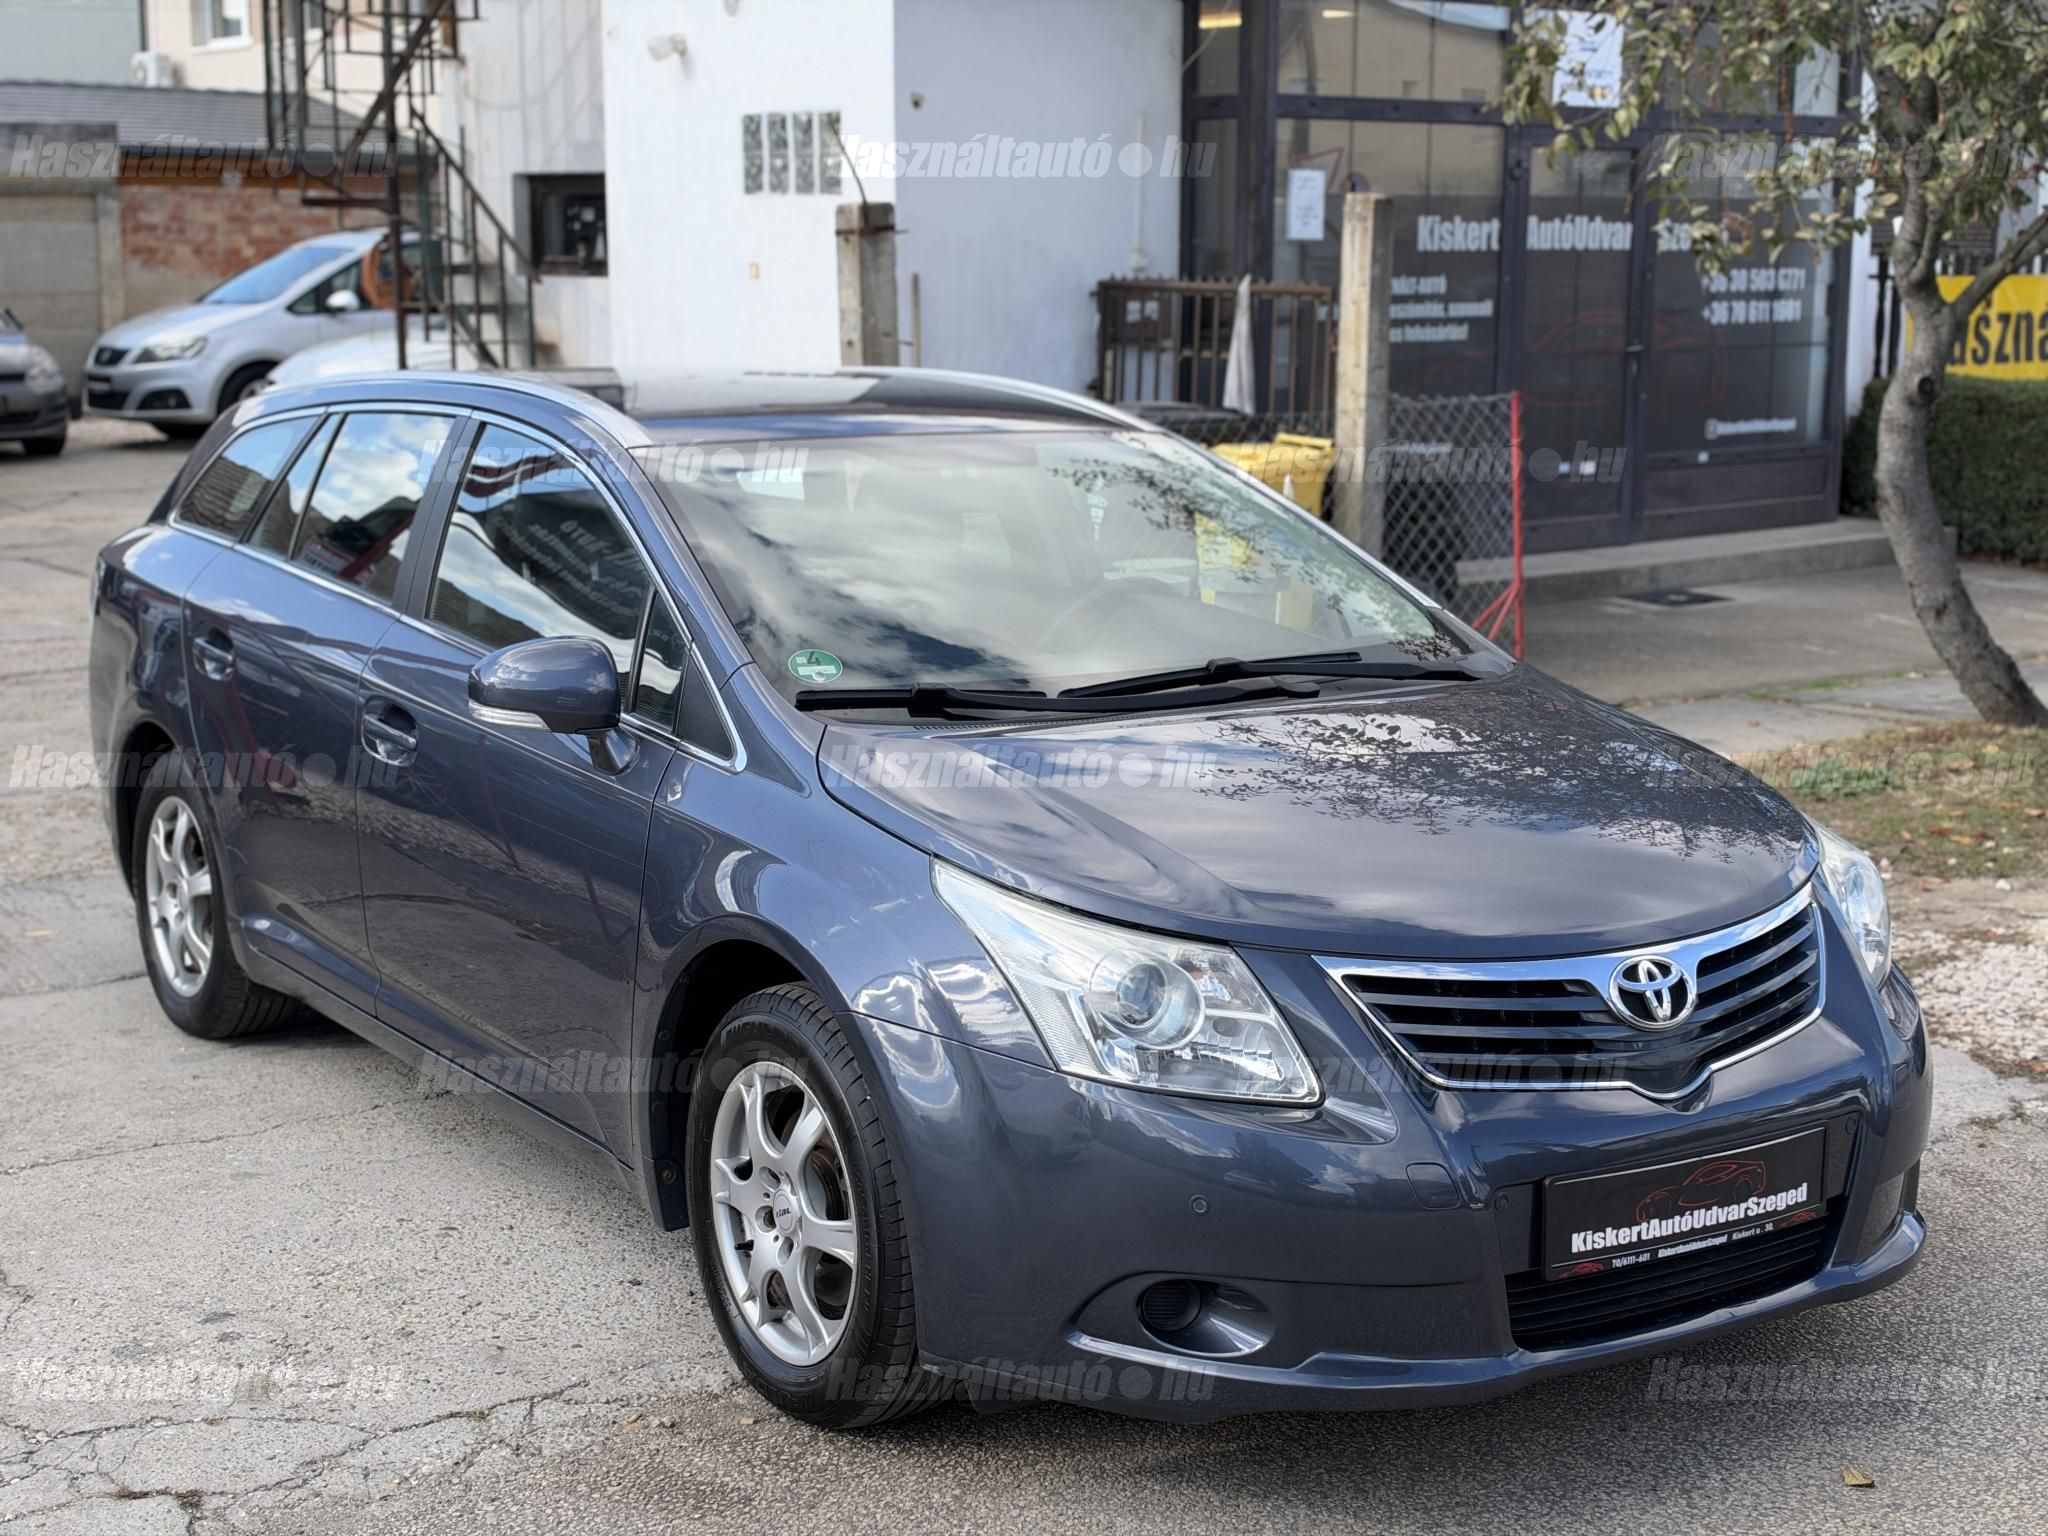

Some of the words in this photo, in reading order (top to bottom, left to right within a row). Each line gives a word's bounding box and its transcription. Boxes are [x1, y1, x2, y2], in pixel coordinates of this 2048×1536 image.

[1417, 214, 1501, 252] Kiskert
[1525, 213, 1634, 252] AutóUdvar
[1570, 1182, 1809, 1254] KiskertAutóUdvarSzeged
